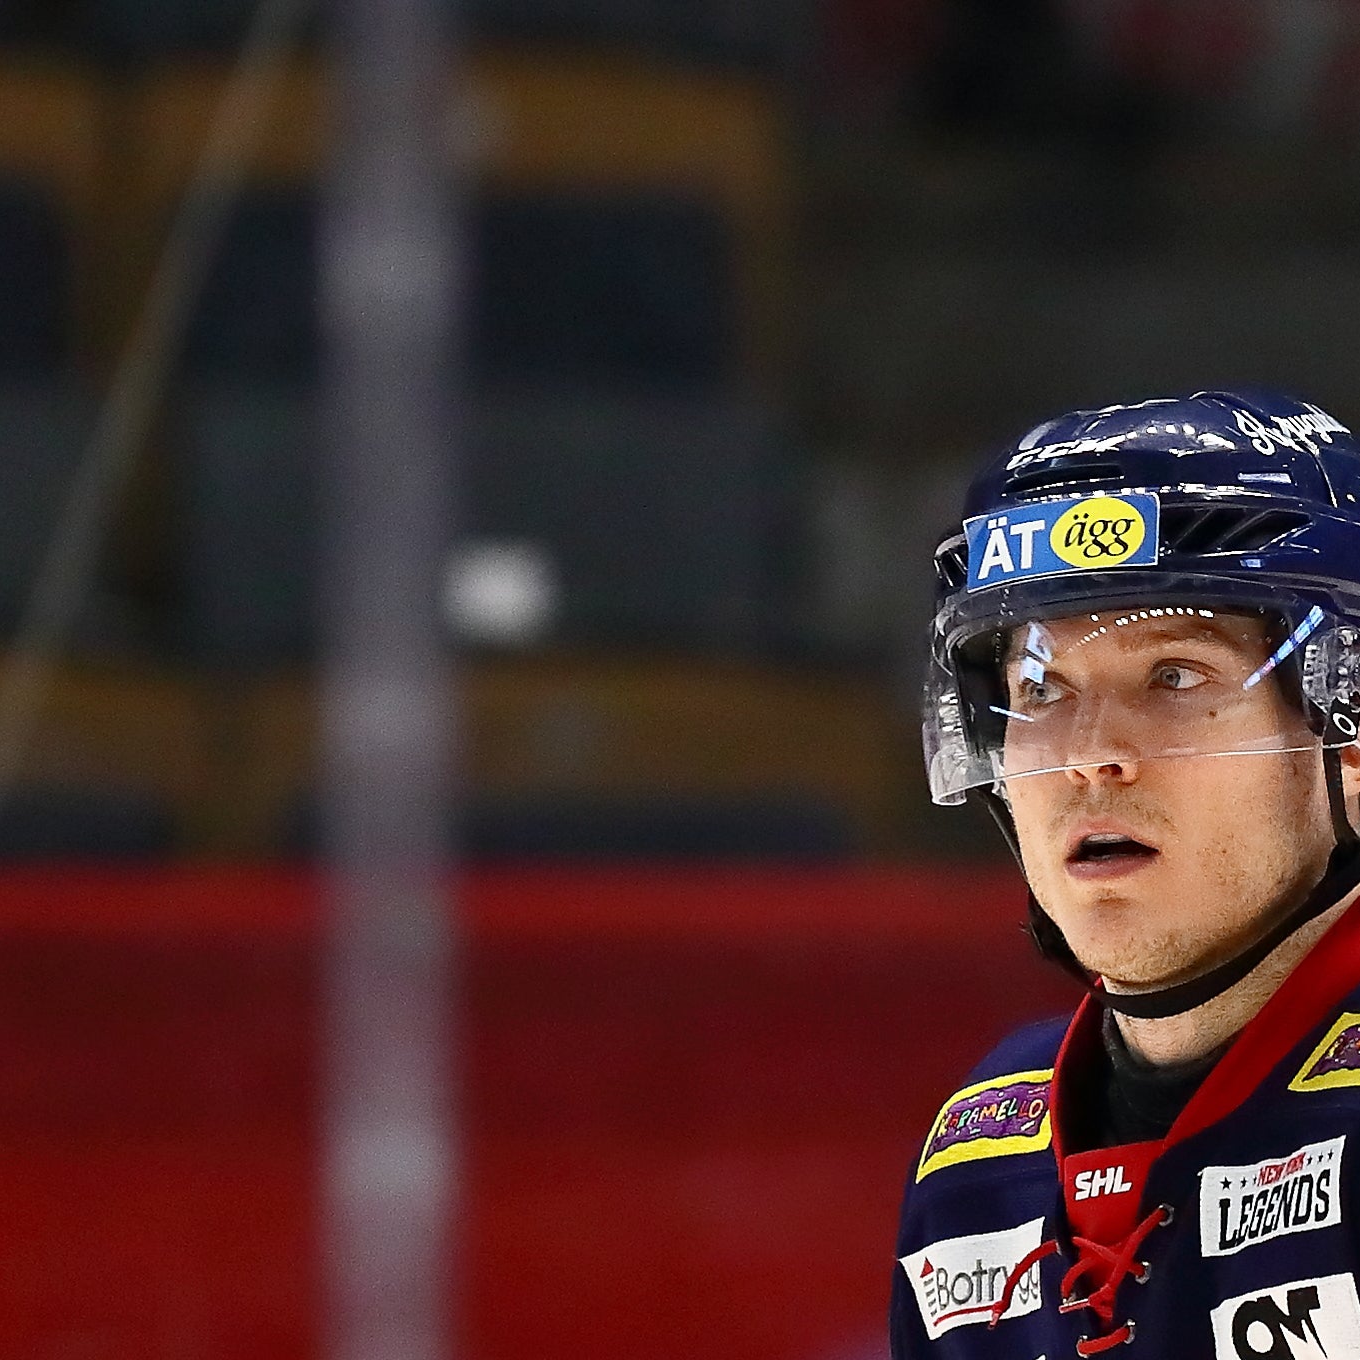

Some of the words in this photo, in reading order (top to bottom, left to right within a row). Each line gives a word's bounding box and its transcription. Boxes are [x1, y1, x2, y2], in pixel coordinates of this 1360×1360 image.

[977, 516, 1045, 580] ÄT
[1064, 512, 1136, 558] ägg
[1075, 1165, 1133, 1201] SHL
[1218, 1168, 1331, 1251] LEGENDS
